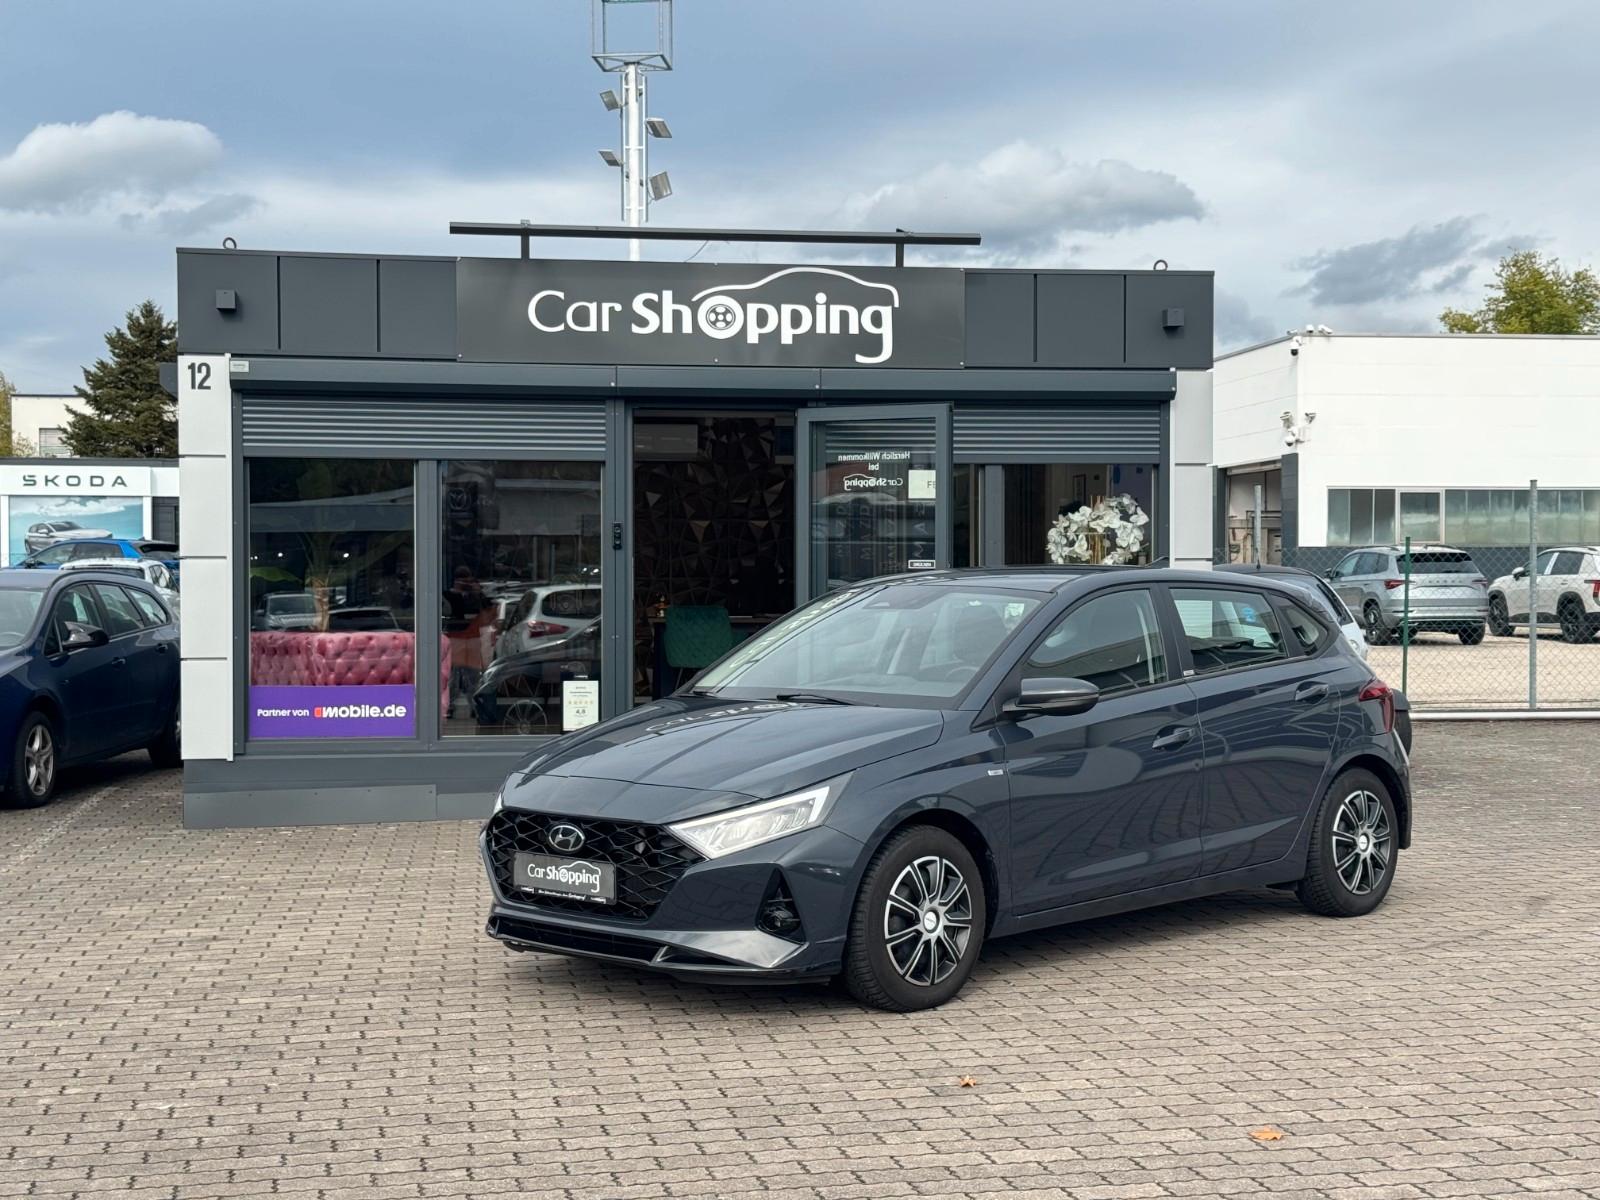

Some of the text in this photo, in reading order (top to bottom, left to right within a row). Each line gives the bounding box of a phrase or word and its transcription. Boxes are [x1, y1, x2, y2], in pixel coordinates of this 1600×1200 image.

[527, 288, 895, 364] Car Shopping
[187, 362, 212, 390] 12
[257, 704, 407, 718] Partner von mobile.de
[527, 863, 600, 893] Car Shopping
